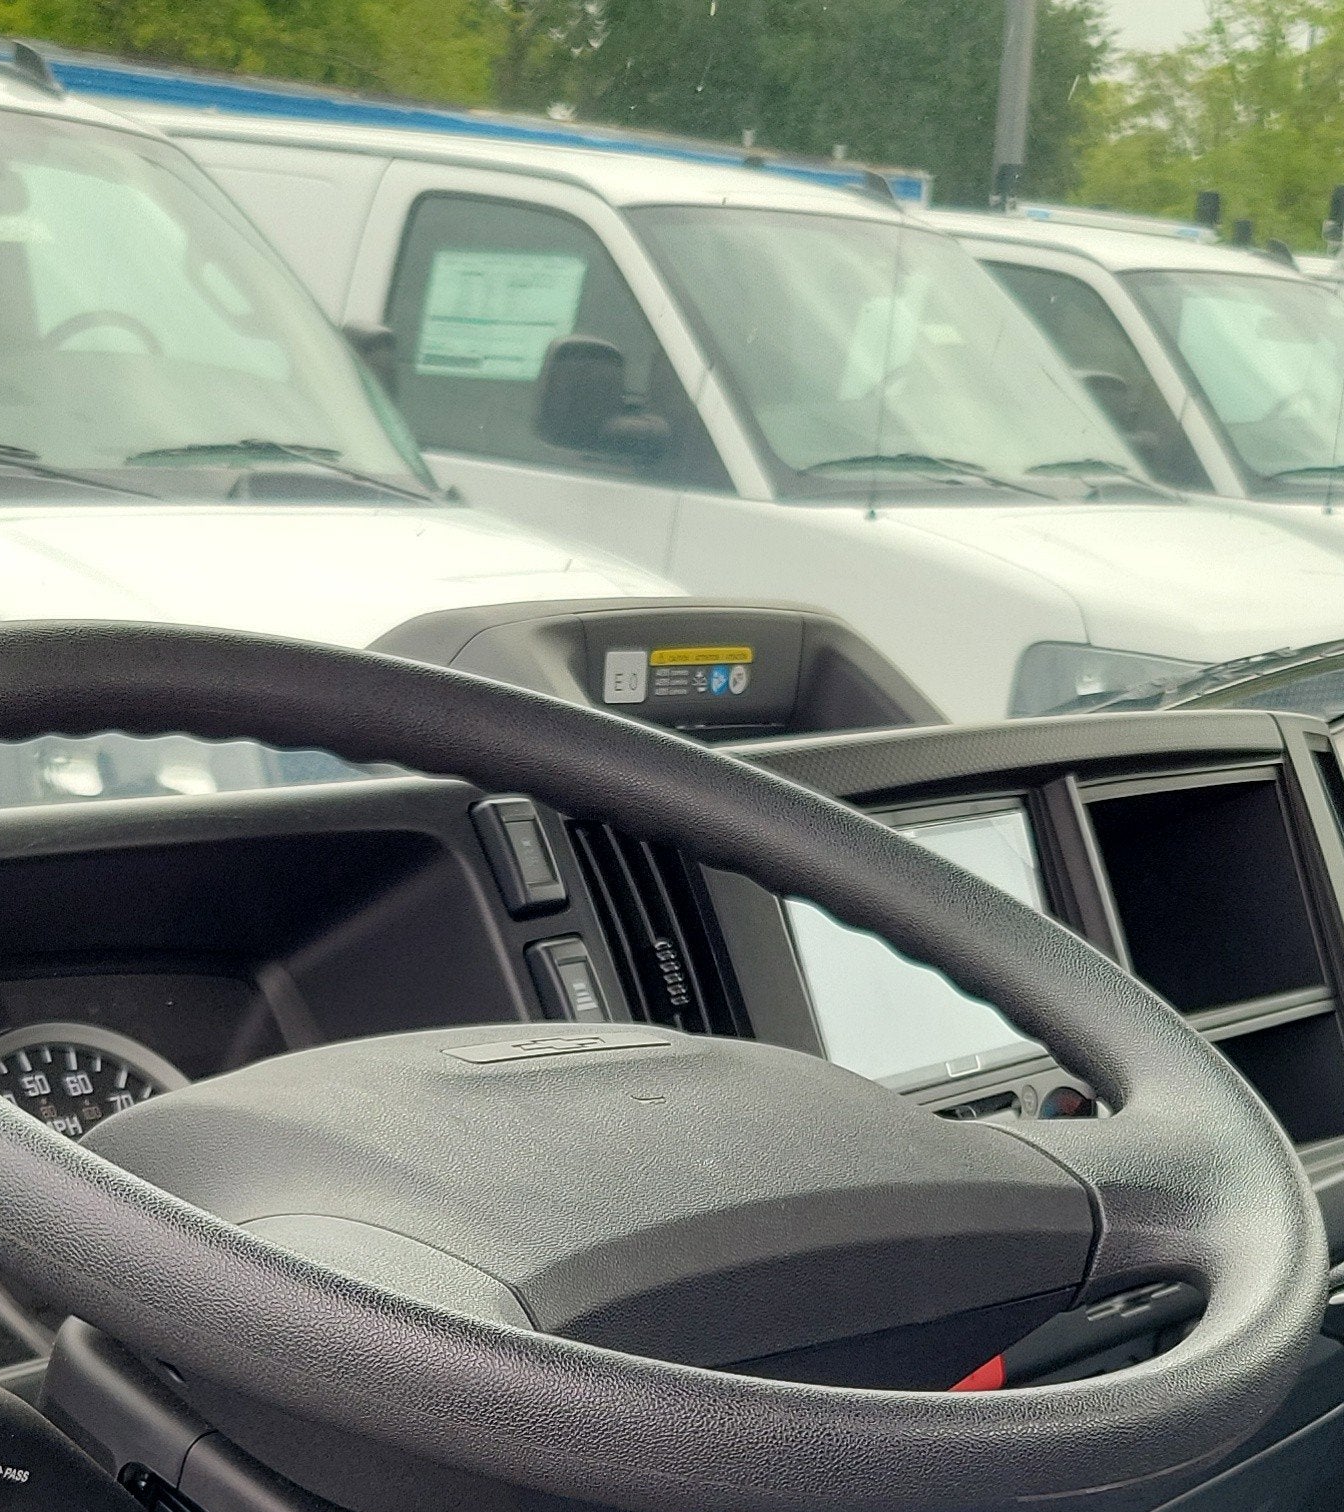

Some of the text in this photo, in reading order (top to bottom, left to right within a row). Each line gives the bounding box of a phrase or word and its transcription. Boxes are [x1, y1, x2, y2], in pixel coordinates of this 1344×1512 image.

[21, 1074, 52, 1097] 50
[66, 1073, 94, 1097] 60
[47, 1114, 83, 1137] PH
[3, 1467, 30, 1483] PASS
